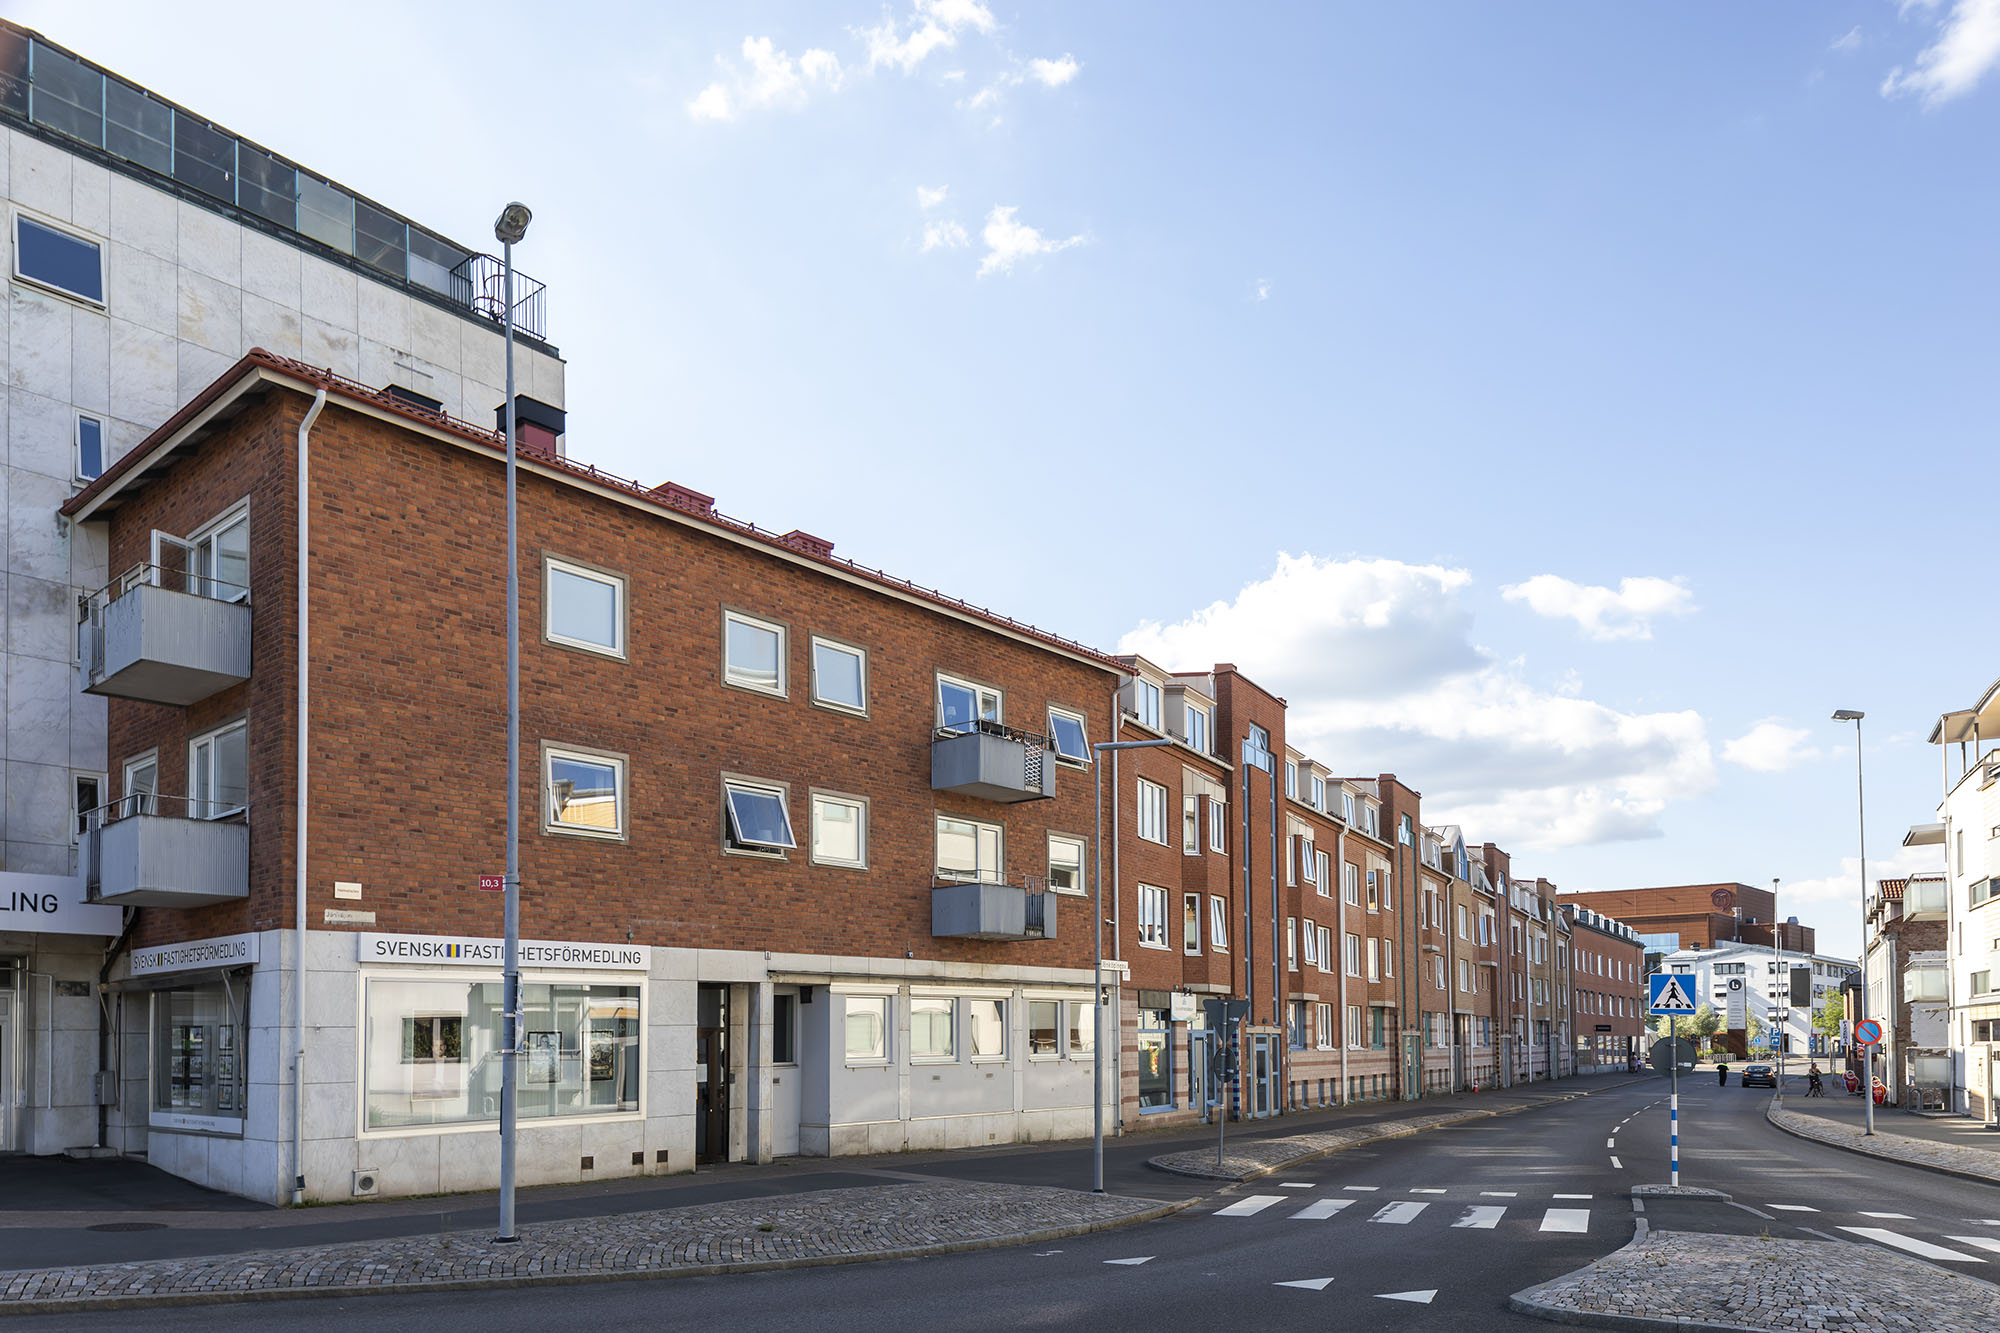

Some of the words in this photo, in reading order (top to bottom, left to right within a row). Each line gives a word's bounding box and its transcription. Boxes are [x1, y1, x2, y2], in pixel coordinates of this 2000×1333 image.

[481, 879, 499, 888] 10,3
[134, 953, 157, 969] SVENSK
[164, 941, 246, 965] FASTIGHETSFÖRMEDLING
[376, 940, 444, 957] SVENSK
[464, 944, 641, 964] FASTIHETSFÖRMEDLING
